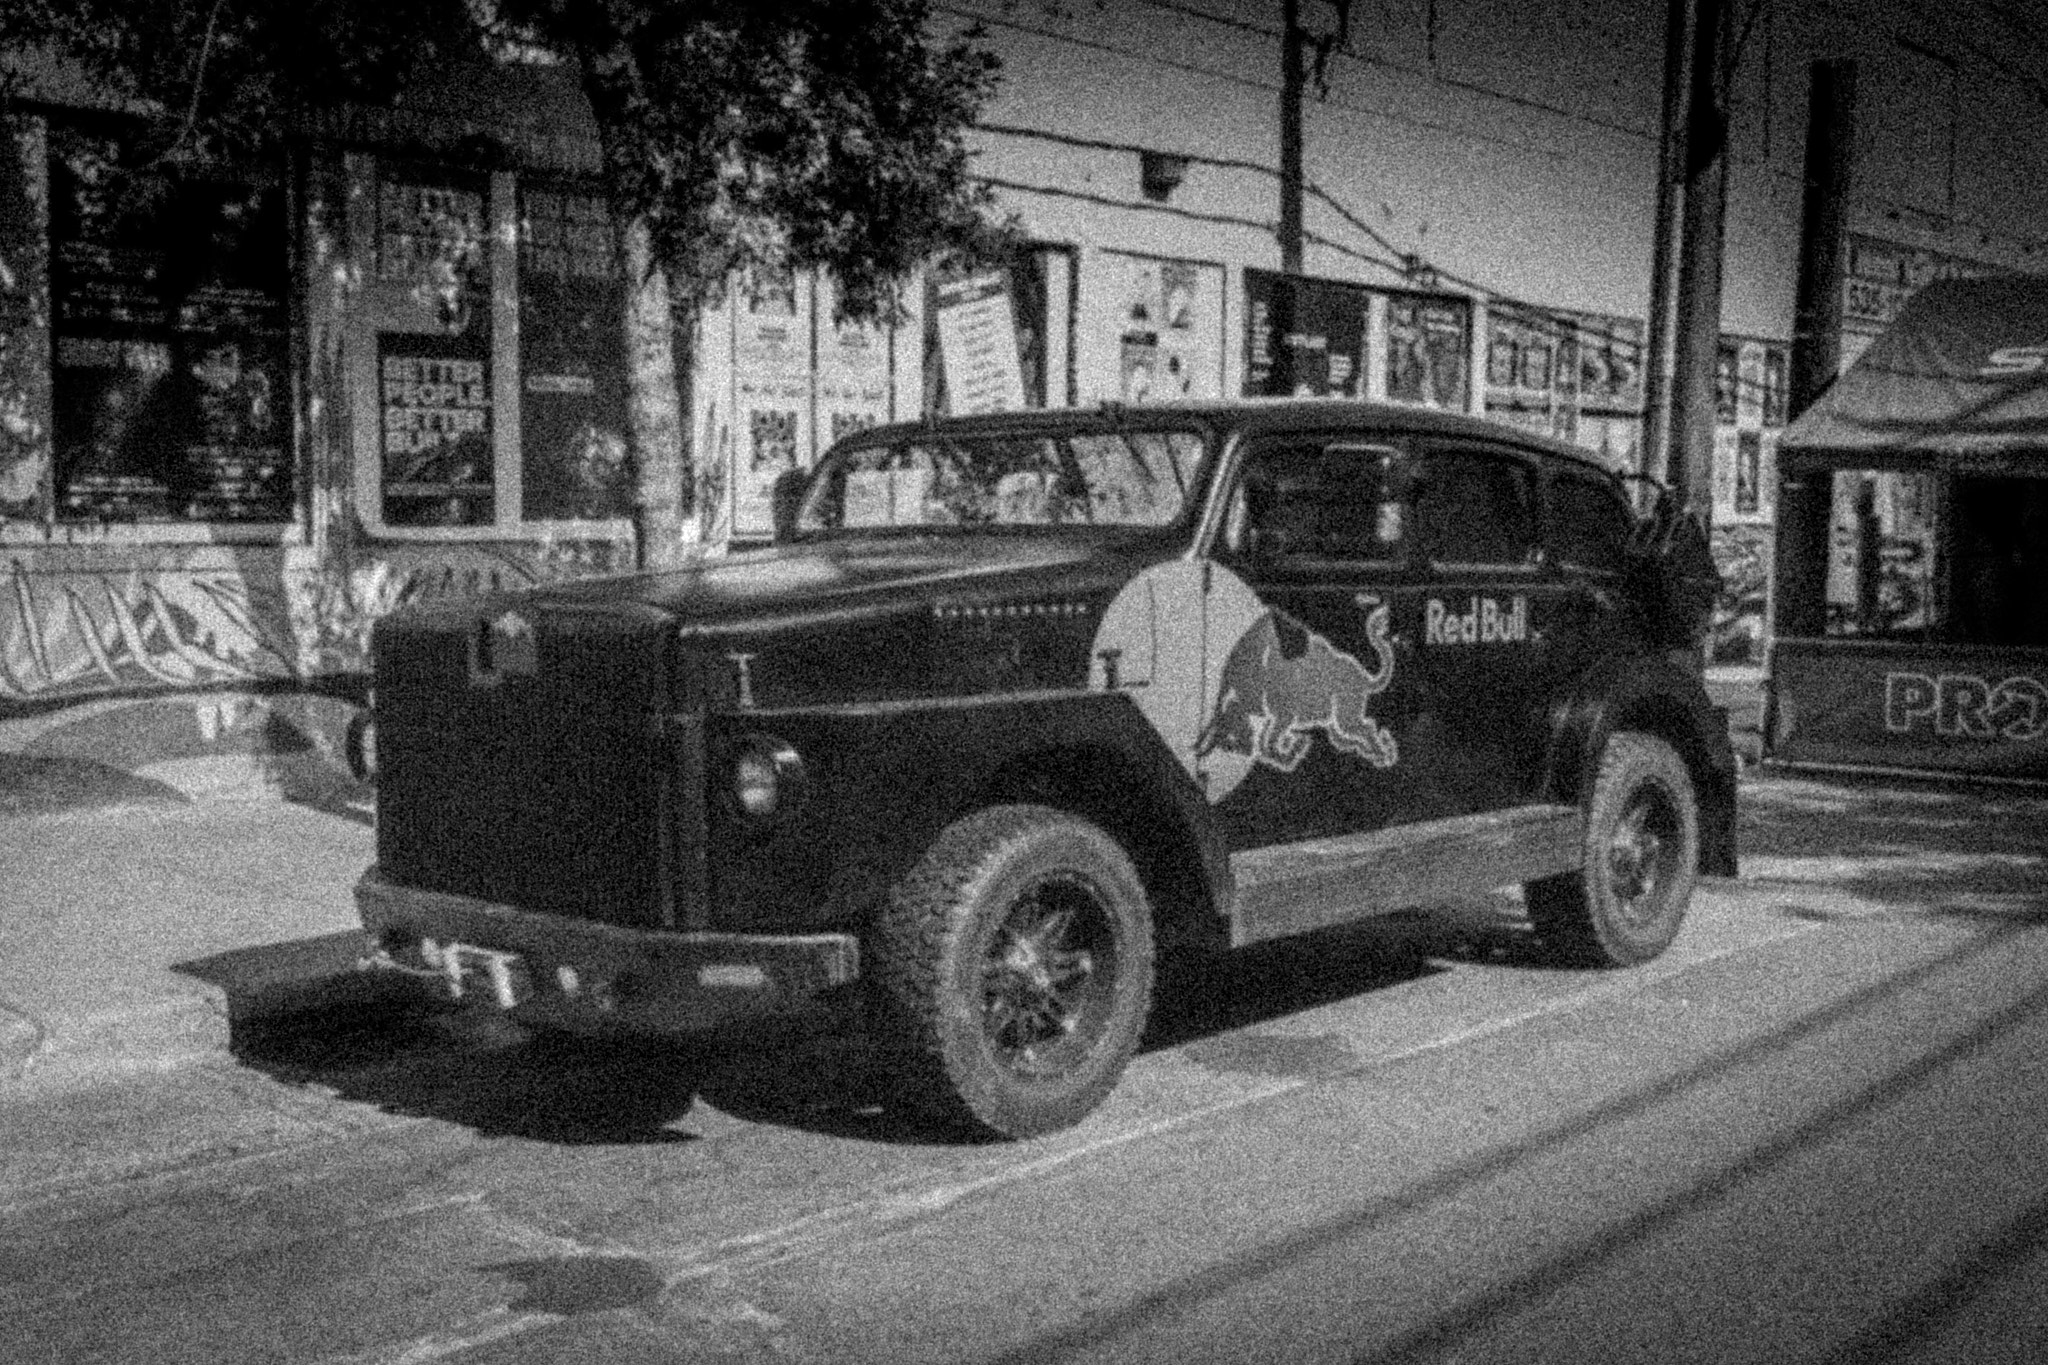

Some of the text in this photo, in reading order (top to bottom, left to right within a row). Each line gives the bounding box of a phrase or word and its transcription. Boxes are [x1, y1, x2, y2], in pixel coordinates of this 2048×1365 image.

[384, 357, 483, 383] BETTER
[1980, 346, 2048, 374] S
[385, 405, 485, 433] BETTER
[1425, 595, 1526, 644] Red Bull
